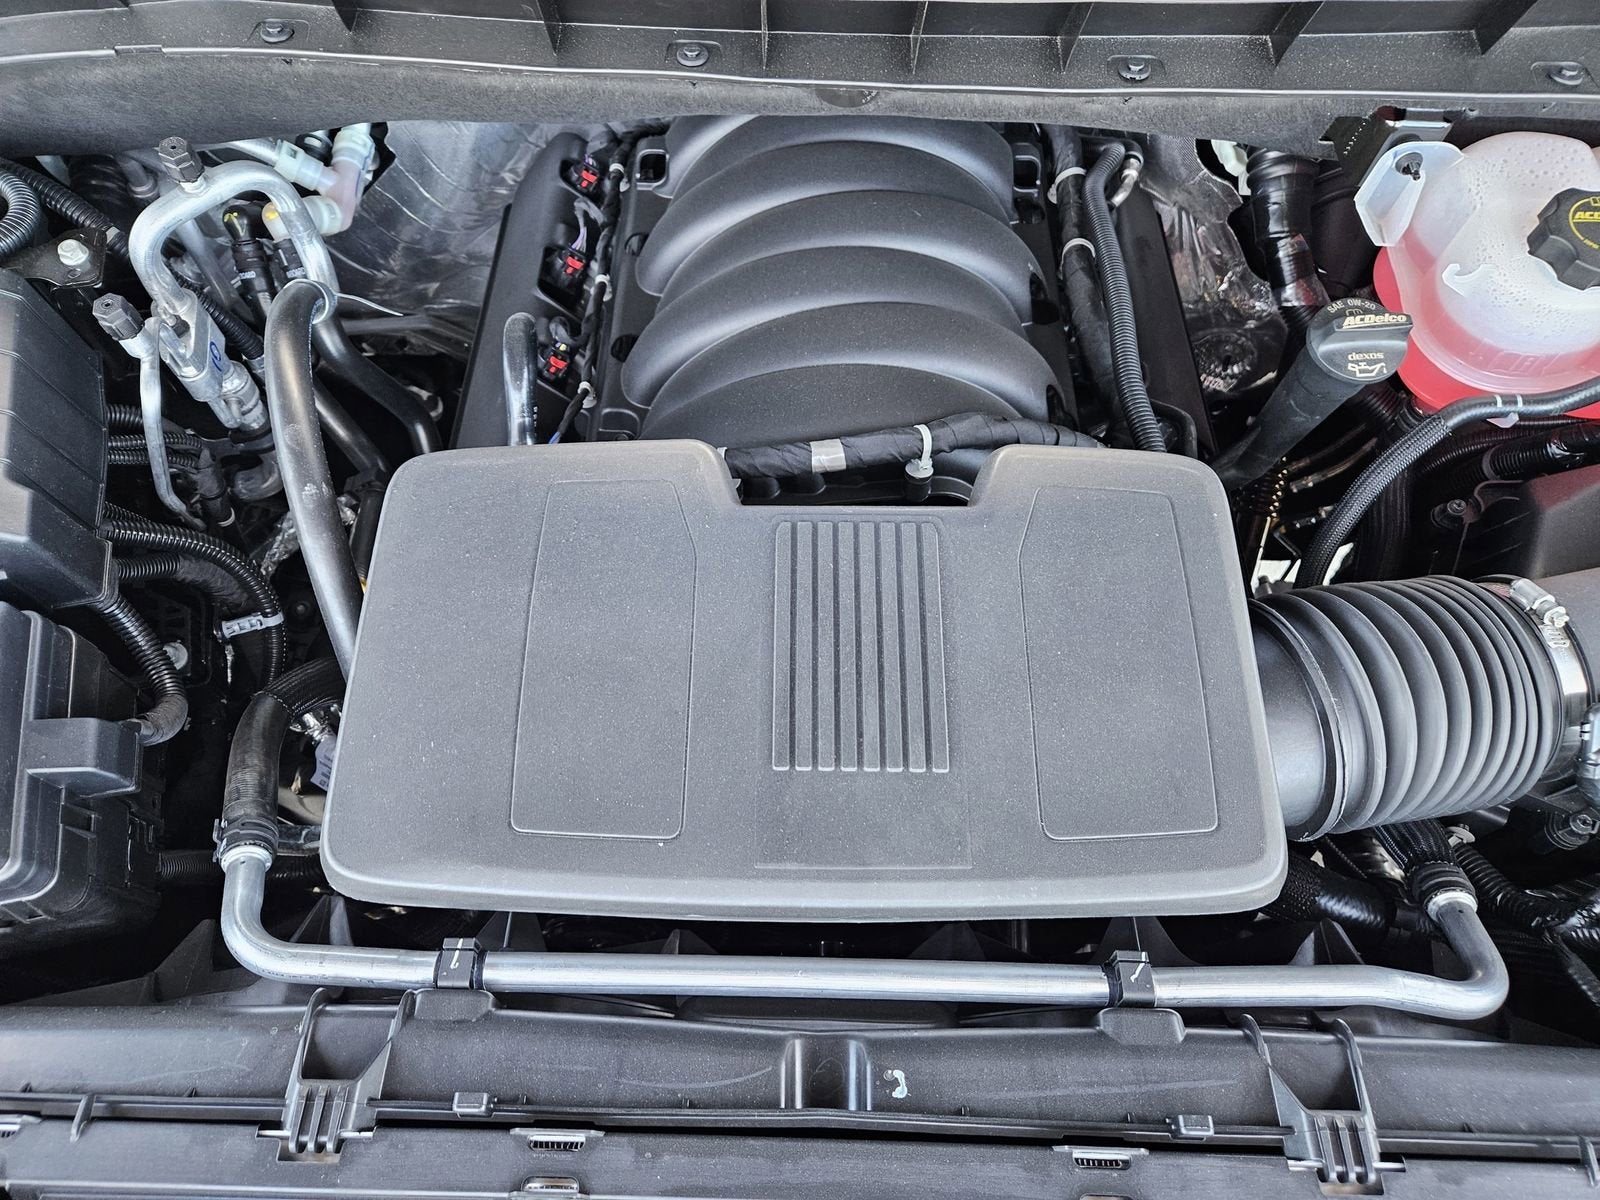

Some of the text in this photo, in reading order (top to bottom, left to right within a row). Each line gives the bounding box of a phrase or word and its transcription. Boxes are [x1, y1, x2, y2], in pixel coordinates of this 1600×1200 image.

[1327, 298, 1376, 313] SAE 0W-20
[1343, 313, 1407, 326] ACDelco
[1347, 352, 1384, 361] dexos
